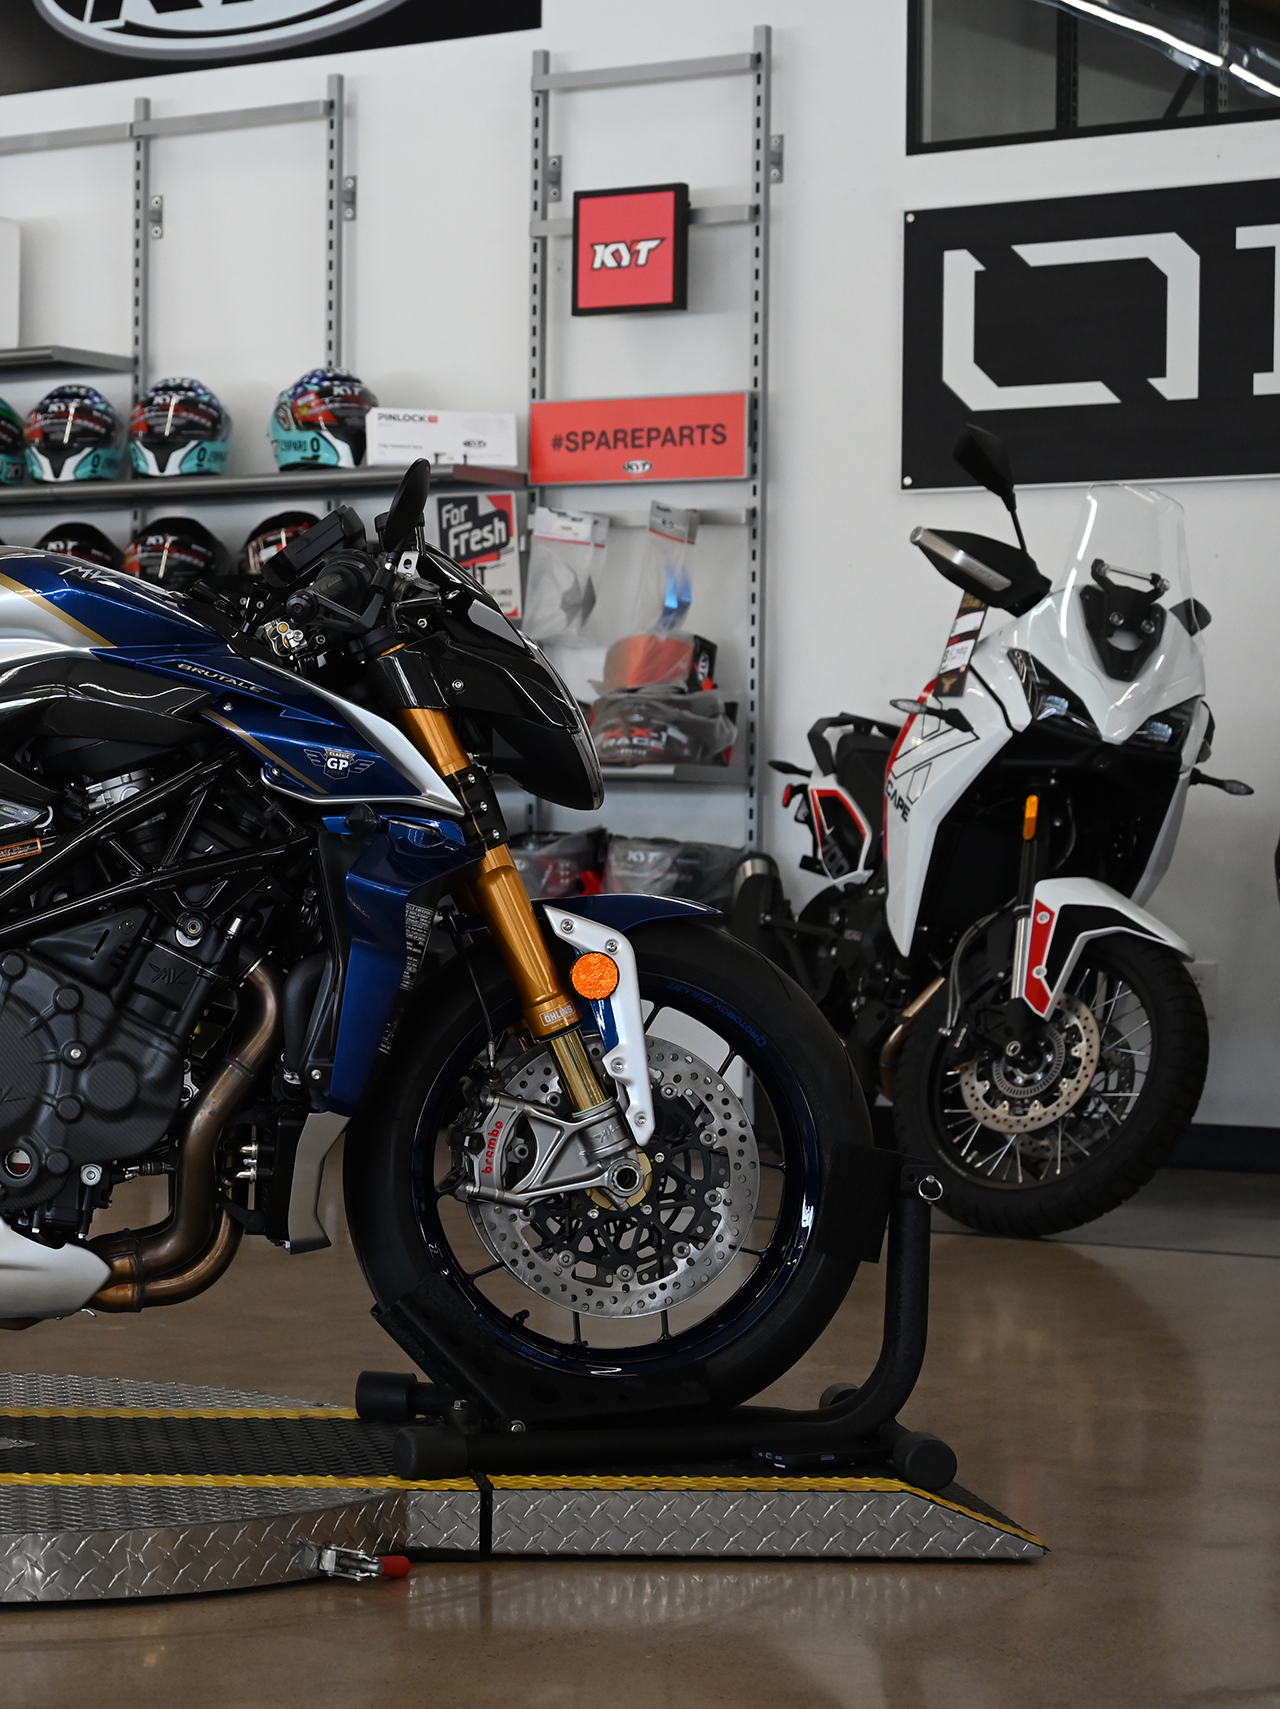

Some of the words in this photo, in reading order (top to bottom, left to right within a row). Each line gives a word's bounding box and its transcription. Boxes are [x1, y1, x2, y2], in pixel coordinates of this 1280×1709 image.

[591, 237, 666, 270] KYT
[551, 423, 727, 452] #SPAREPARTS
[441, 502, 469, 529] For
[448, 517, 507, 558] Fresh
[177, 662, 263, 693] BRUTALE
[326, 757, 349, 770] GP
[885, 779, 910, 823] CAPE
[482, 1121, 503, 1174] brembo
